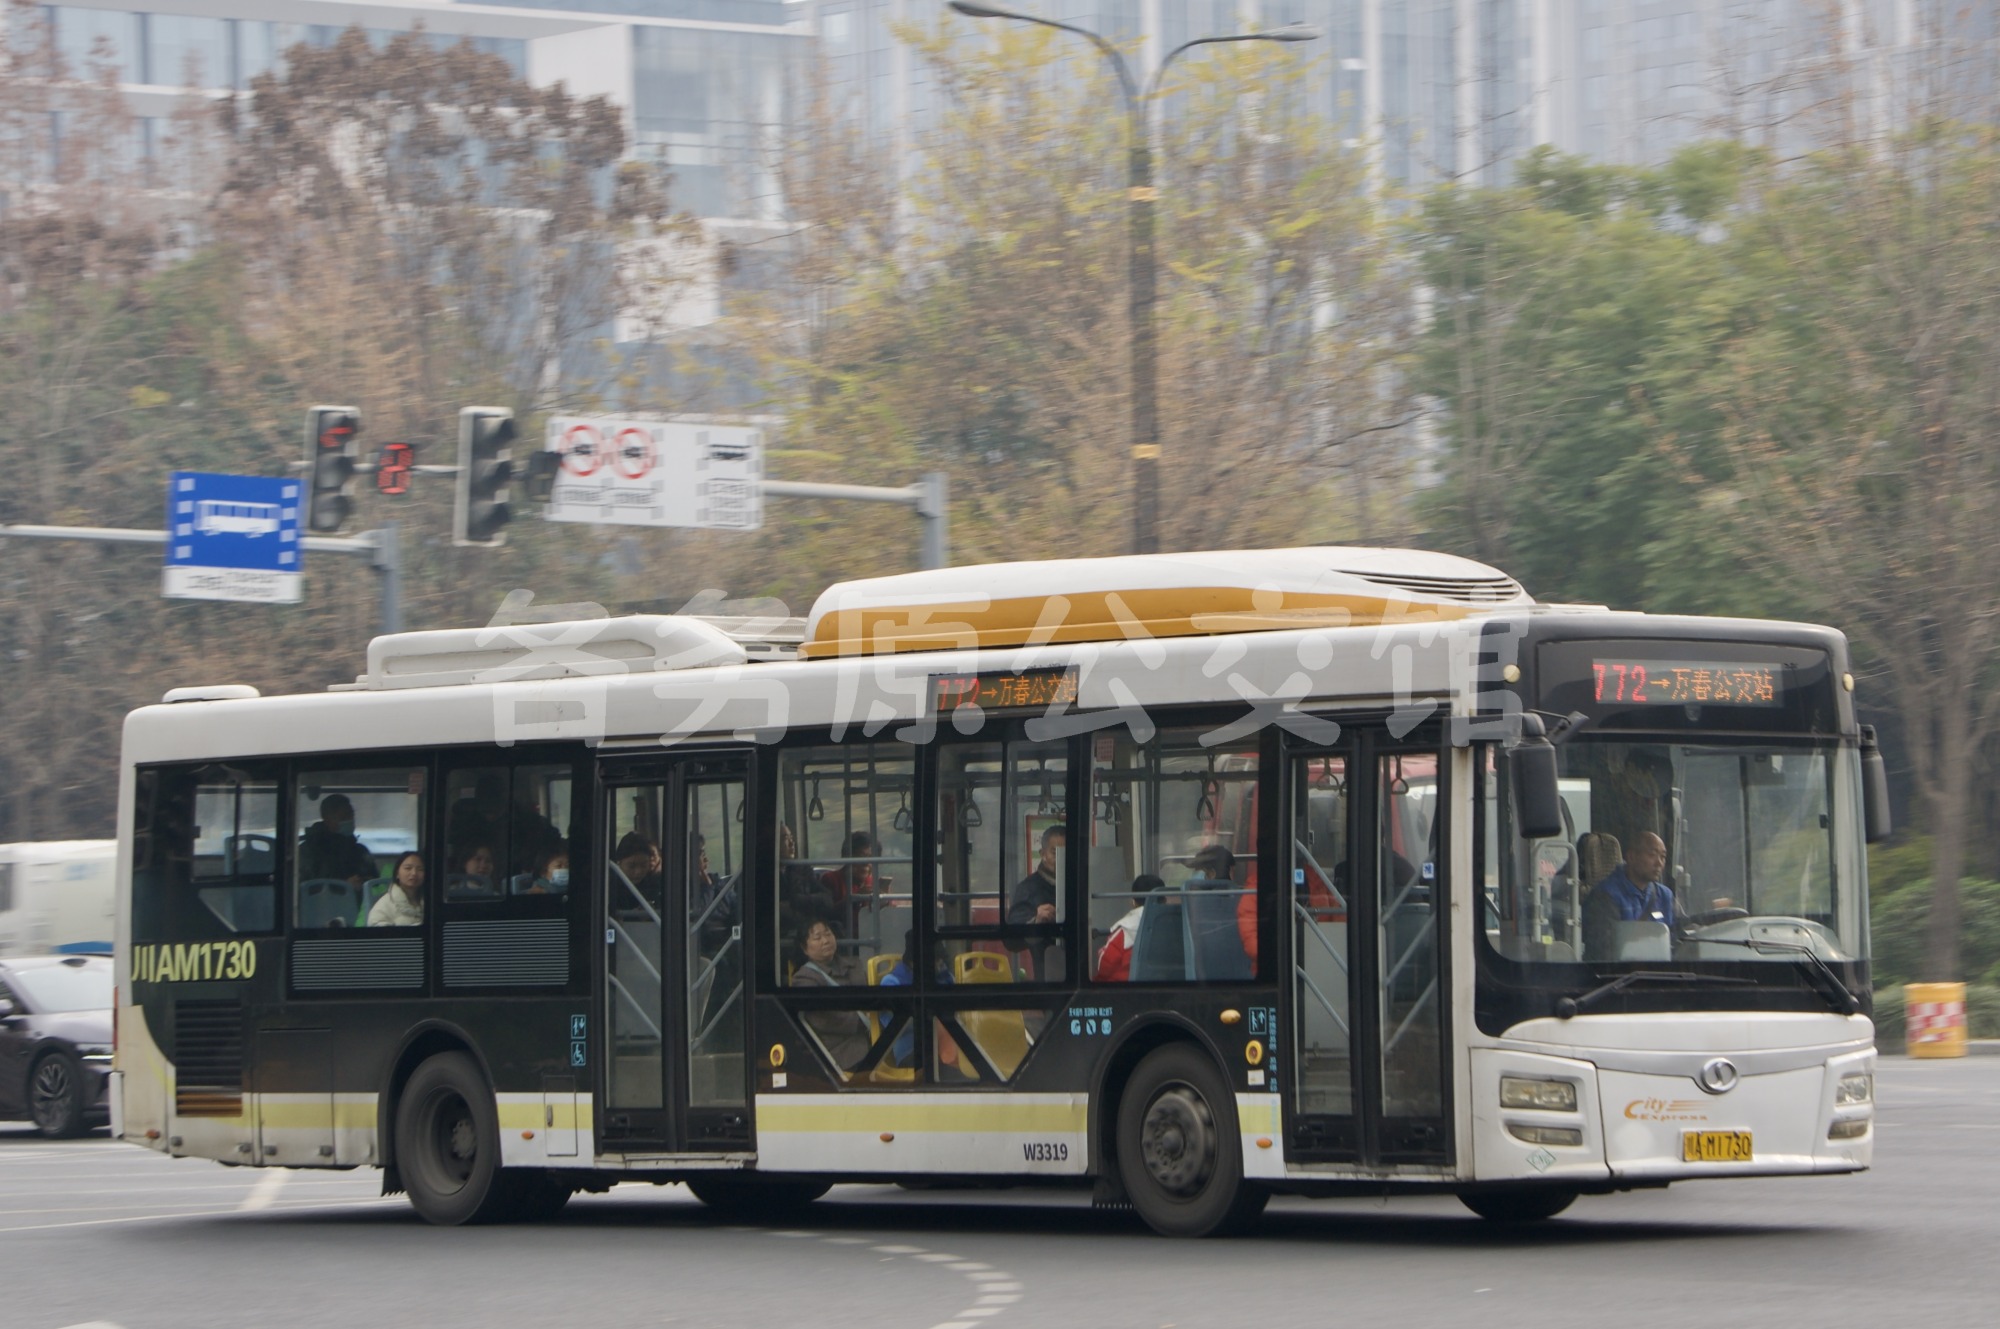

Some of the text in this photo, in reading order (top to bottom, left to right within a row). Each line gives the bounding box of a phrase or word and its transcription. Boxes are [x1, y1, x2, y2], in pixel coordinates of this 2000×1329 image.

[937, 671, 1078, 711] 772 万春公交站
[1592, 663, 1774, 703] 772 万春公交站
[1624, 1097, 1667, 1120] City
[1023, 1143, 1068, 1161] W3319
